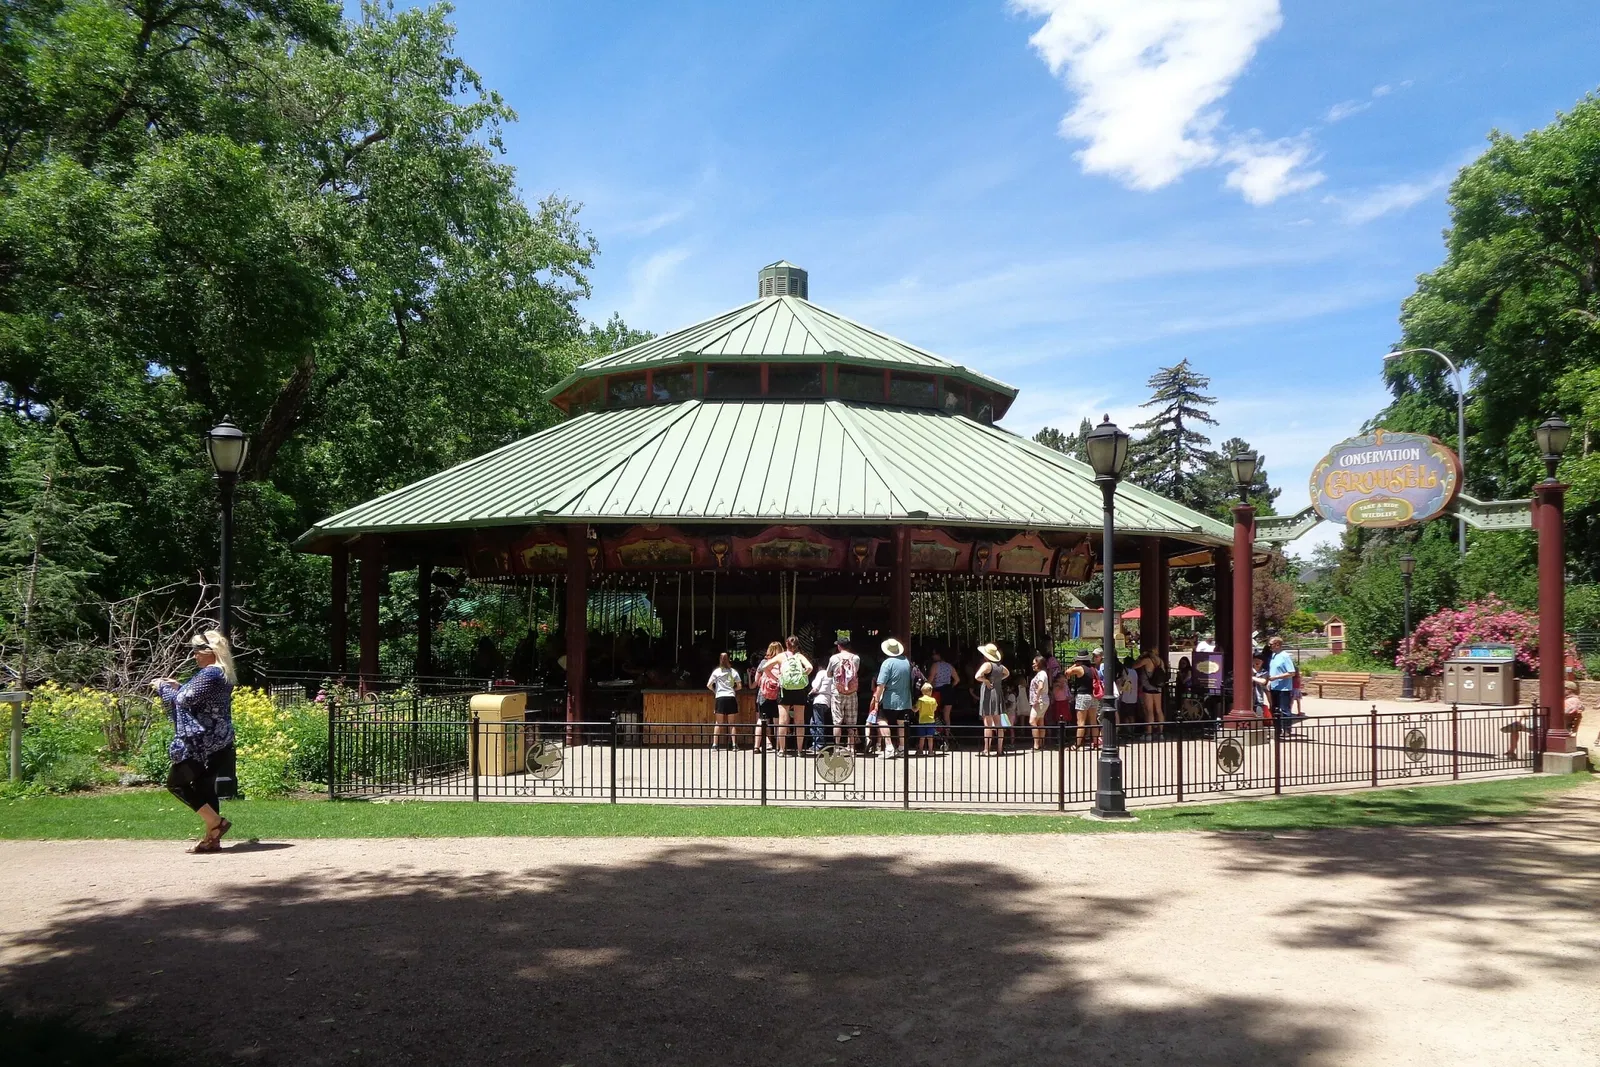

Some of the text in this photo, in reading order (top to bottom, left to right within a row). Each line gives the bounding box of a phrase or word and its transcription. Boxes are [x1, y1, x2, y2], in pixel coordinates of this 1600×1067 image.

[1339, 448, 1420, 467] CONSERVATION
[1324, 463, 1438, 499] CAROUSEL
[1359, 503, 1376, 511] TAKE
